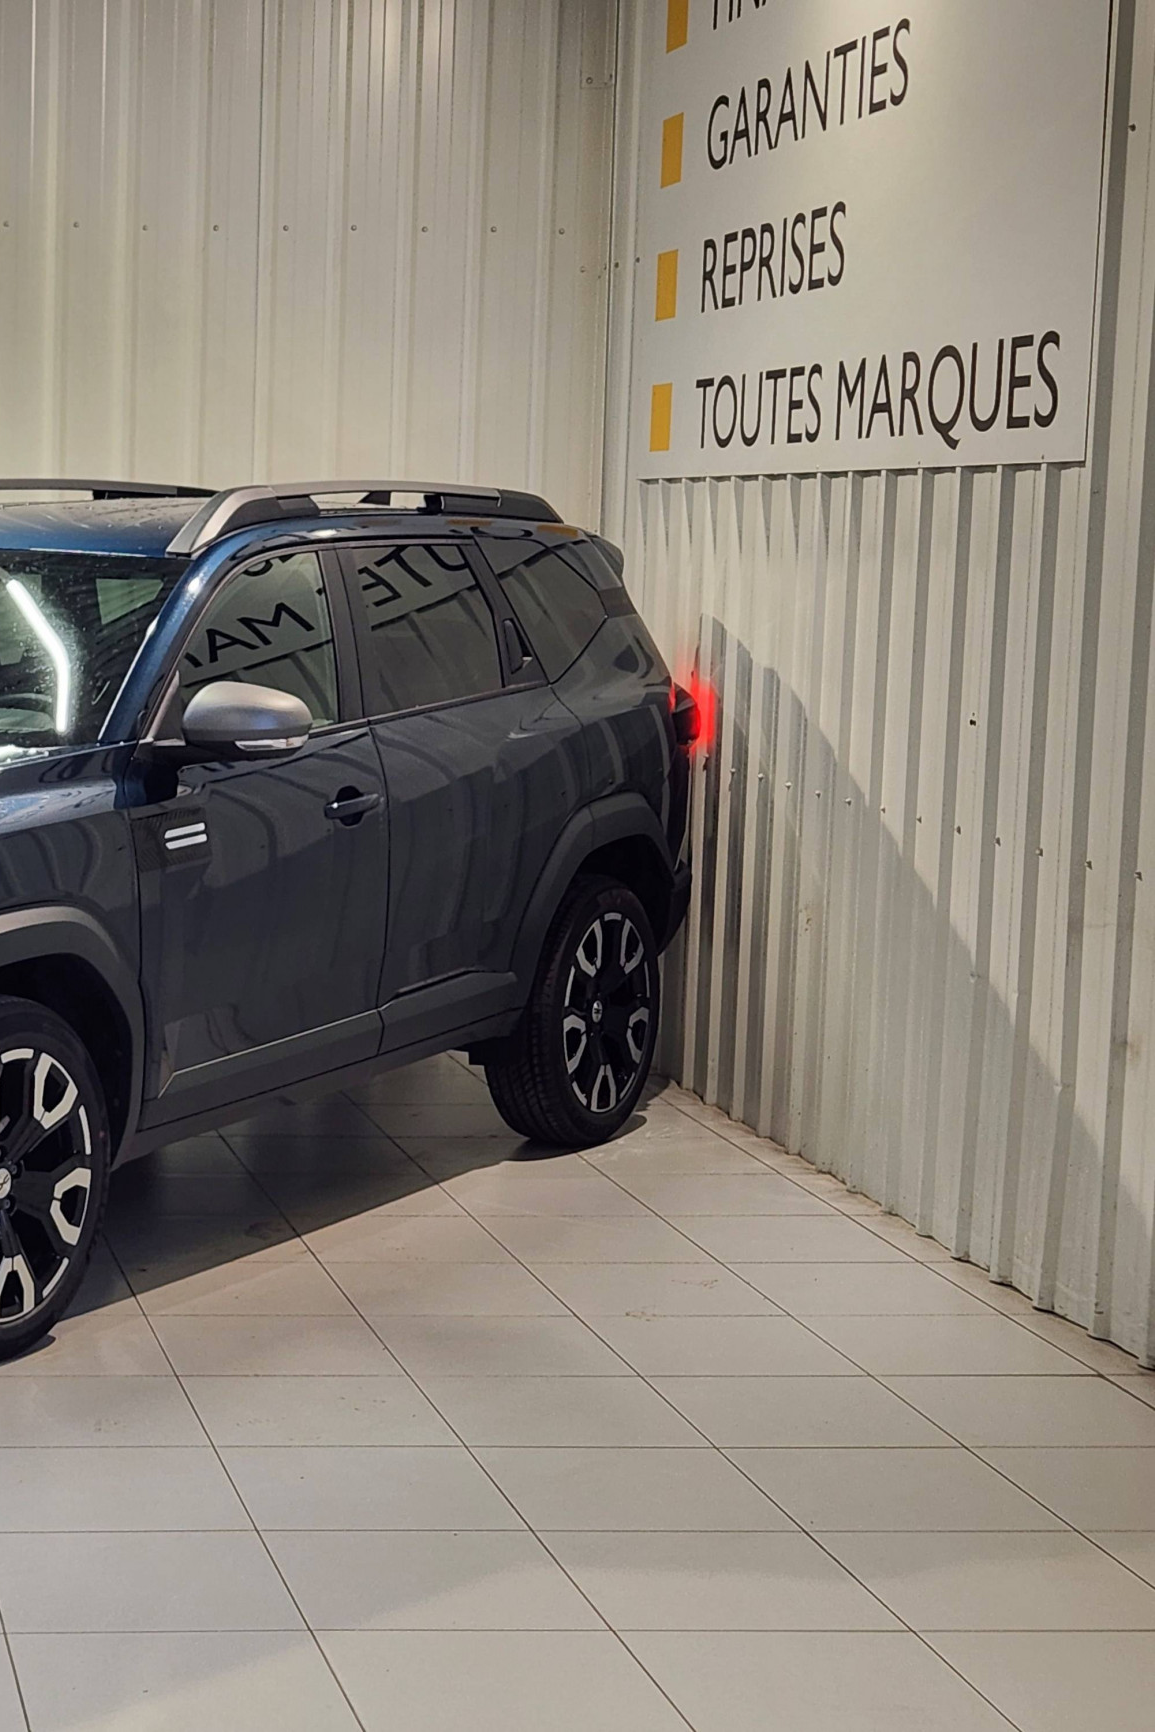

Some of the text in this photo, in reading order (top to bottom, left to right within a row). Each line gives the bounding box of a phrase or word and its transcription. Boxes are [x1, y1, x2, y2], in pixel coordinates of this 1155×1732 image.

[706, 18, 911, 170] GARANTIES
[701, 201, 847, 313] REPRISES
[695, 330, 1060, 451] TOUTES MARQUES
